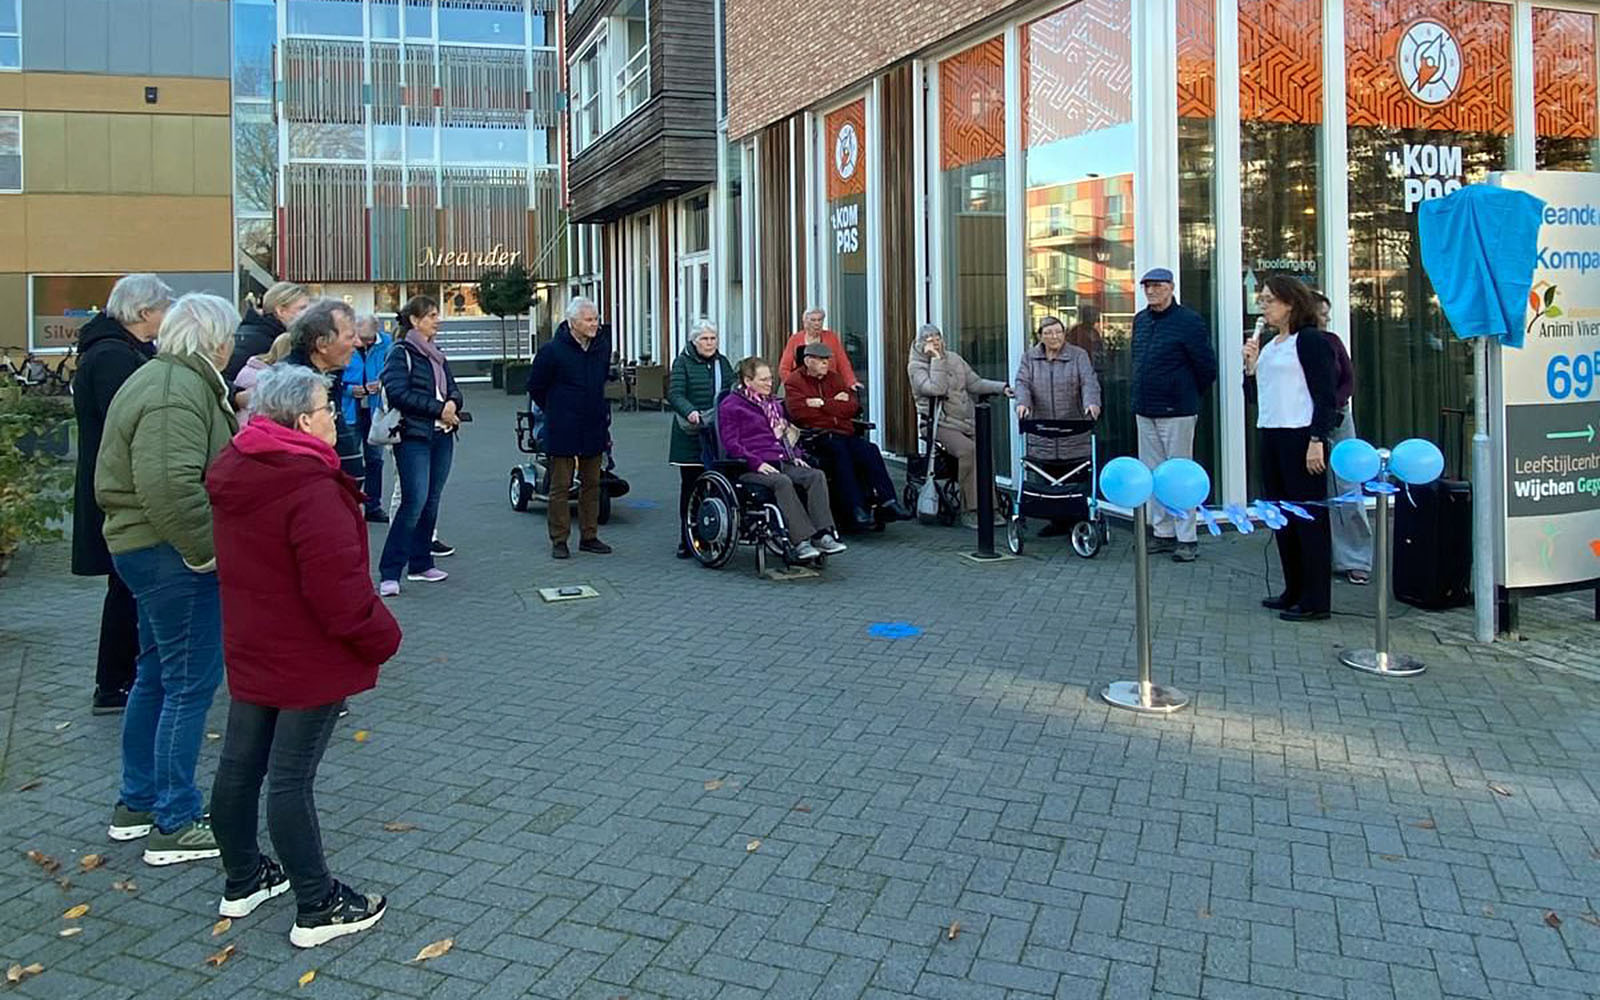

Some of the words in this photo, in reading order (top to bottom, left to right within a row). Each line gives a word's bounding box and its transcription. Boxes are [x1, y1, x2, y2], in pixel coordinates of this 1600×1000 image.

[1403, 144, 1462, 176] KOM
[836, 203, 859, 229] KOM
[1543, 203, 1600, 226] eande
[836, 227, 859, 254] PAS
[1540, 320, 1574, 338] Animi
[1514, 479, 1575, 501] Wijchen
